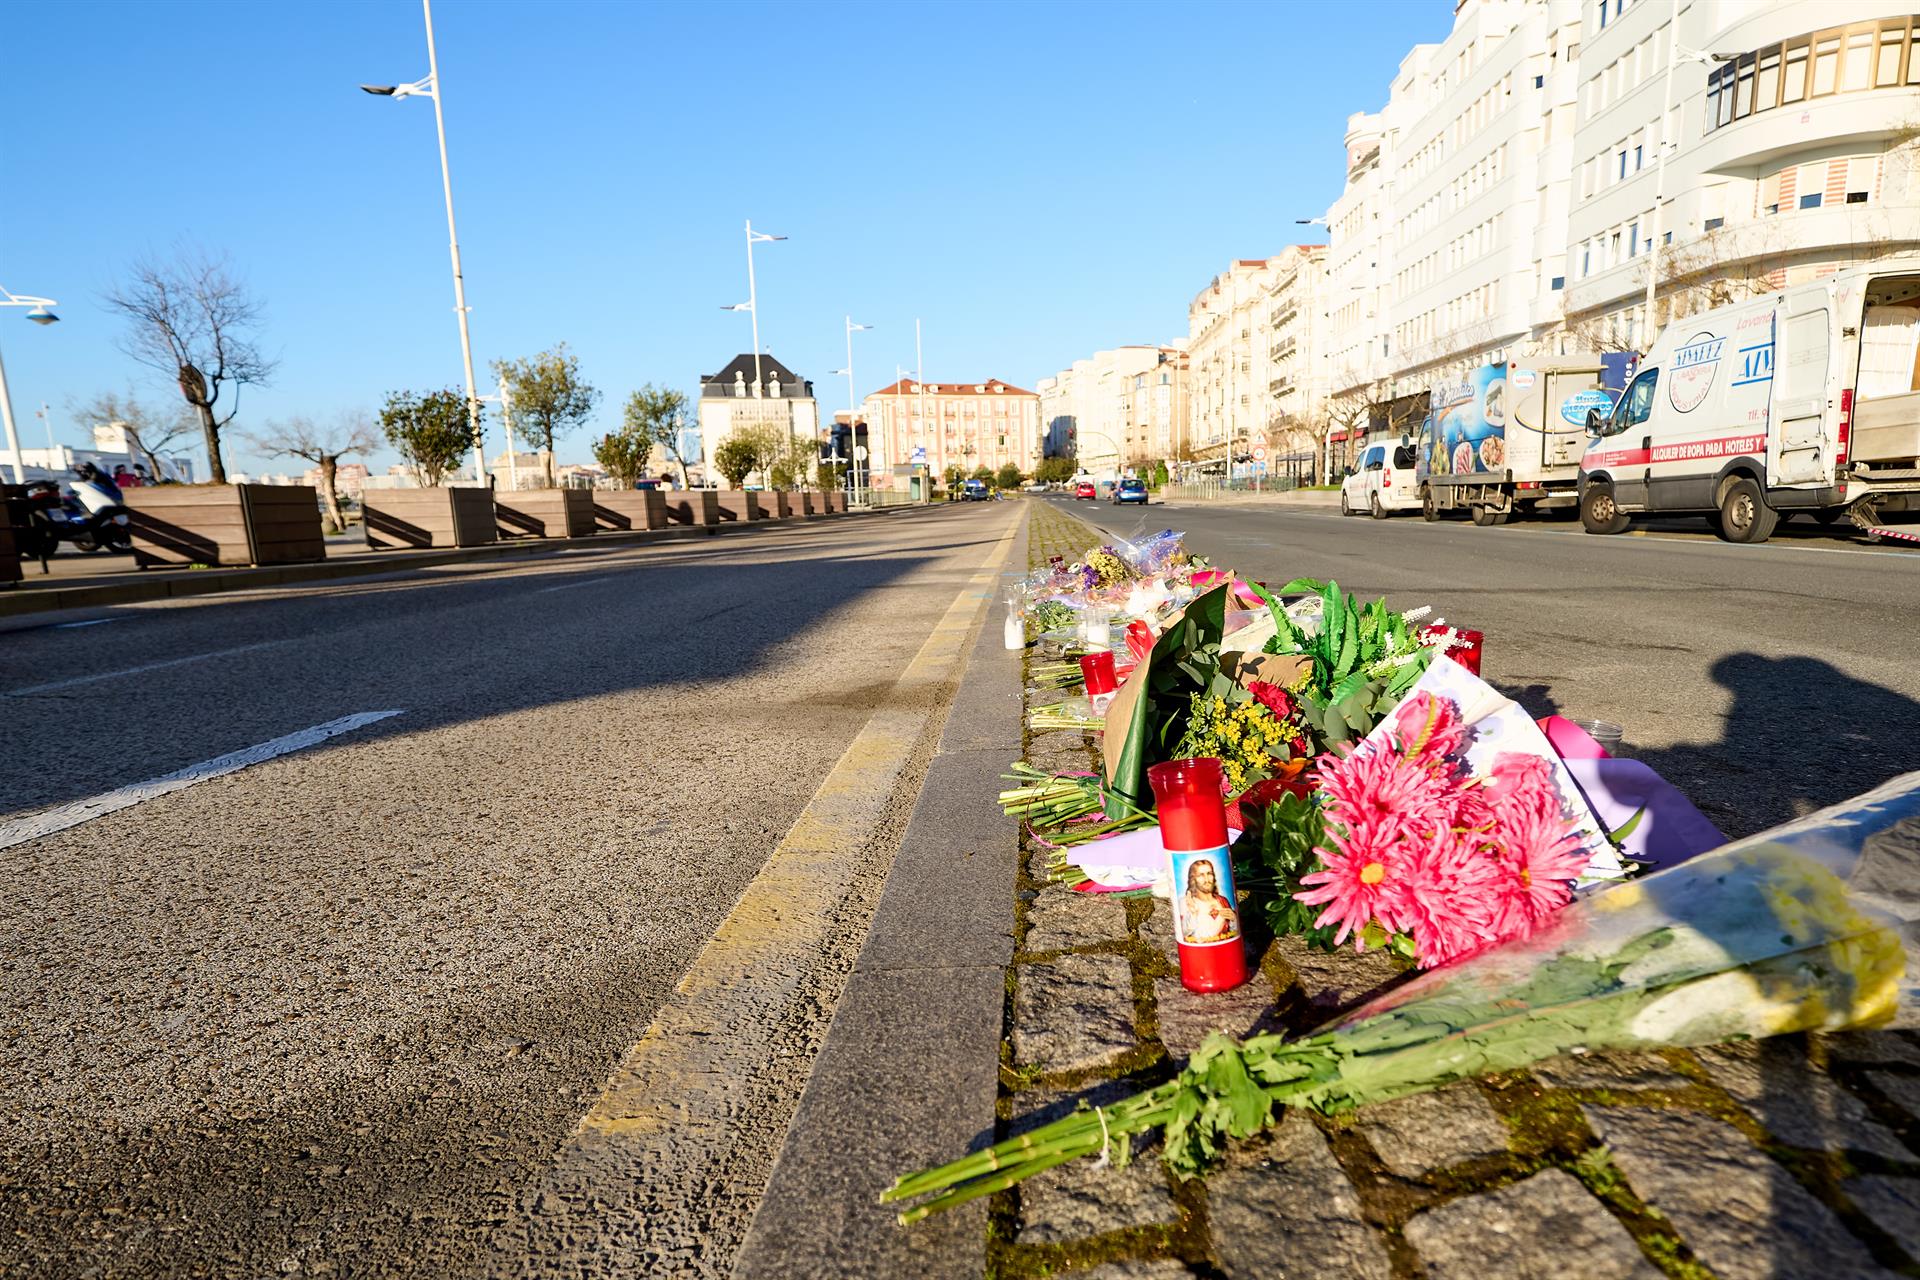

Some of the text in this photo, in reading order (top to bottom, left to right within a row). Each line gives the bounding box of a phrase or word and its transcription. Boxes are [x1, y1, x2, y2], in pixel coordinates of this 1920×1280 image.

[1738, 348, 1773, 378] ALV
[1652, 447, 1679, 461] ALQUILER
[1679, 445, 1687, 459] DE
[1687, 444, 1704, 457] ROPA
[1705, 441, 1723, 456] PARA
[1725, 438, 1754, 454] HOTELES
[1755, 437, 1761, 451] Y
